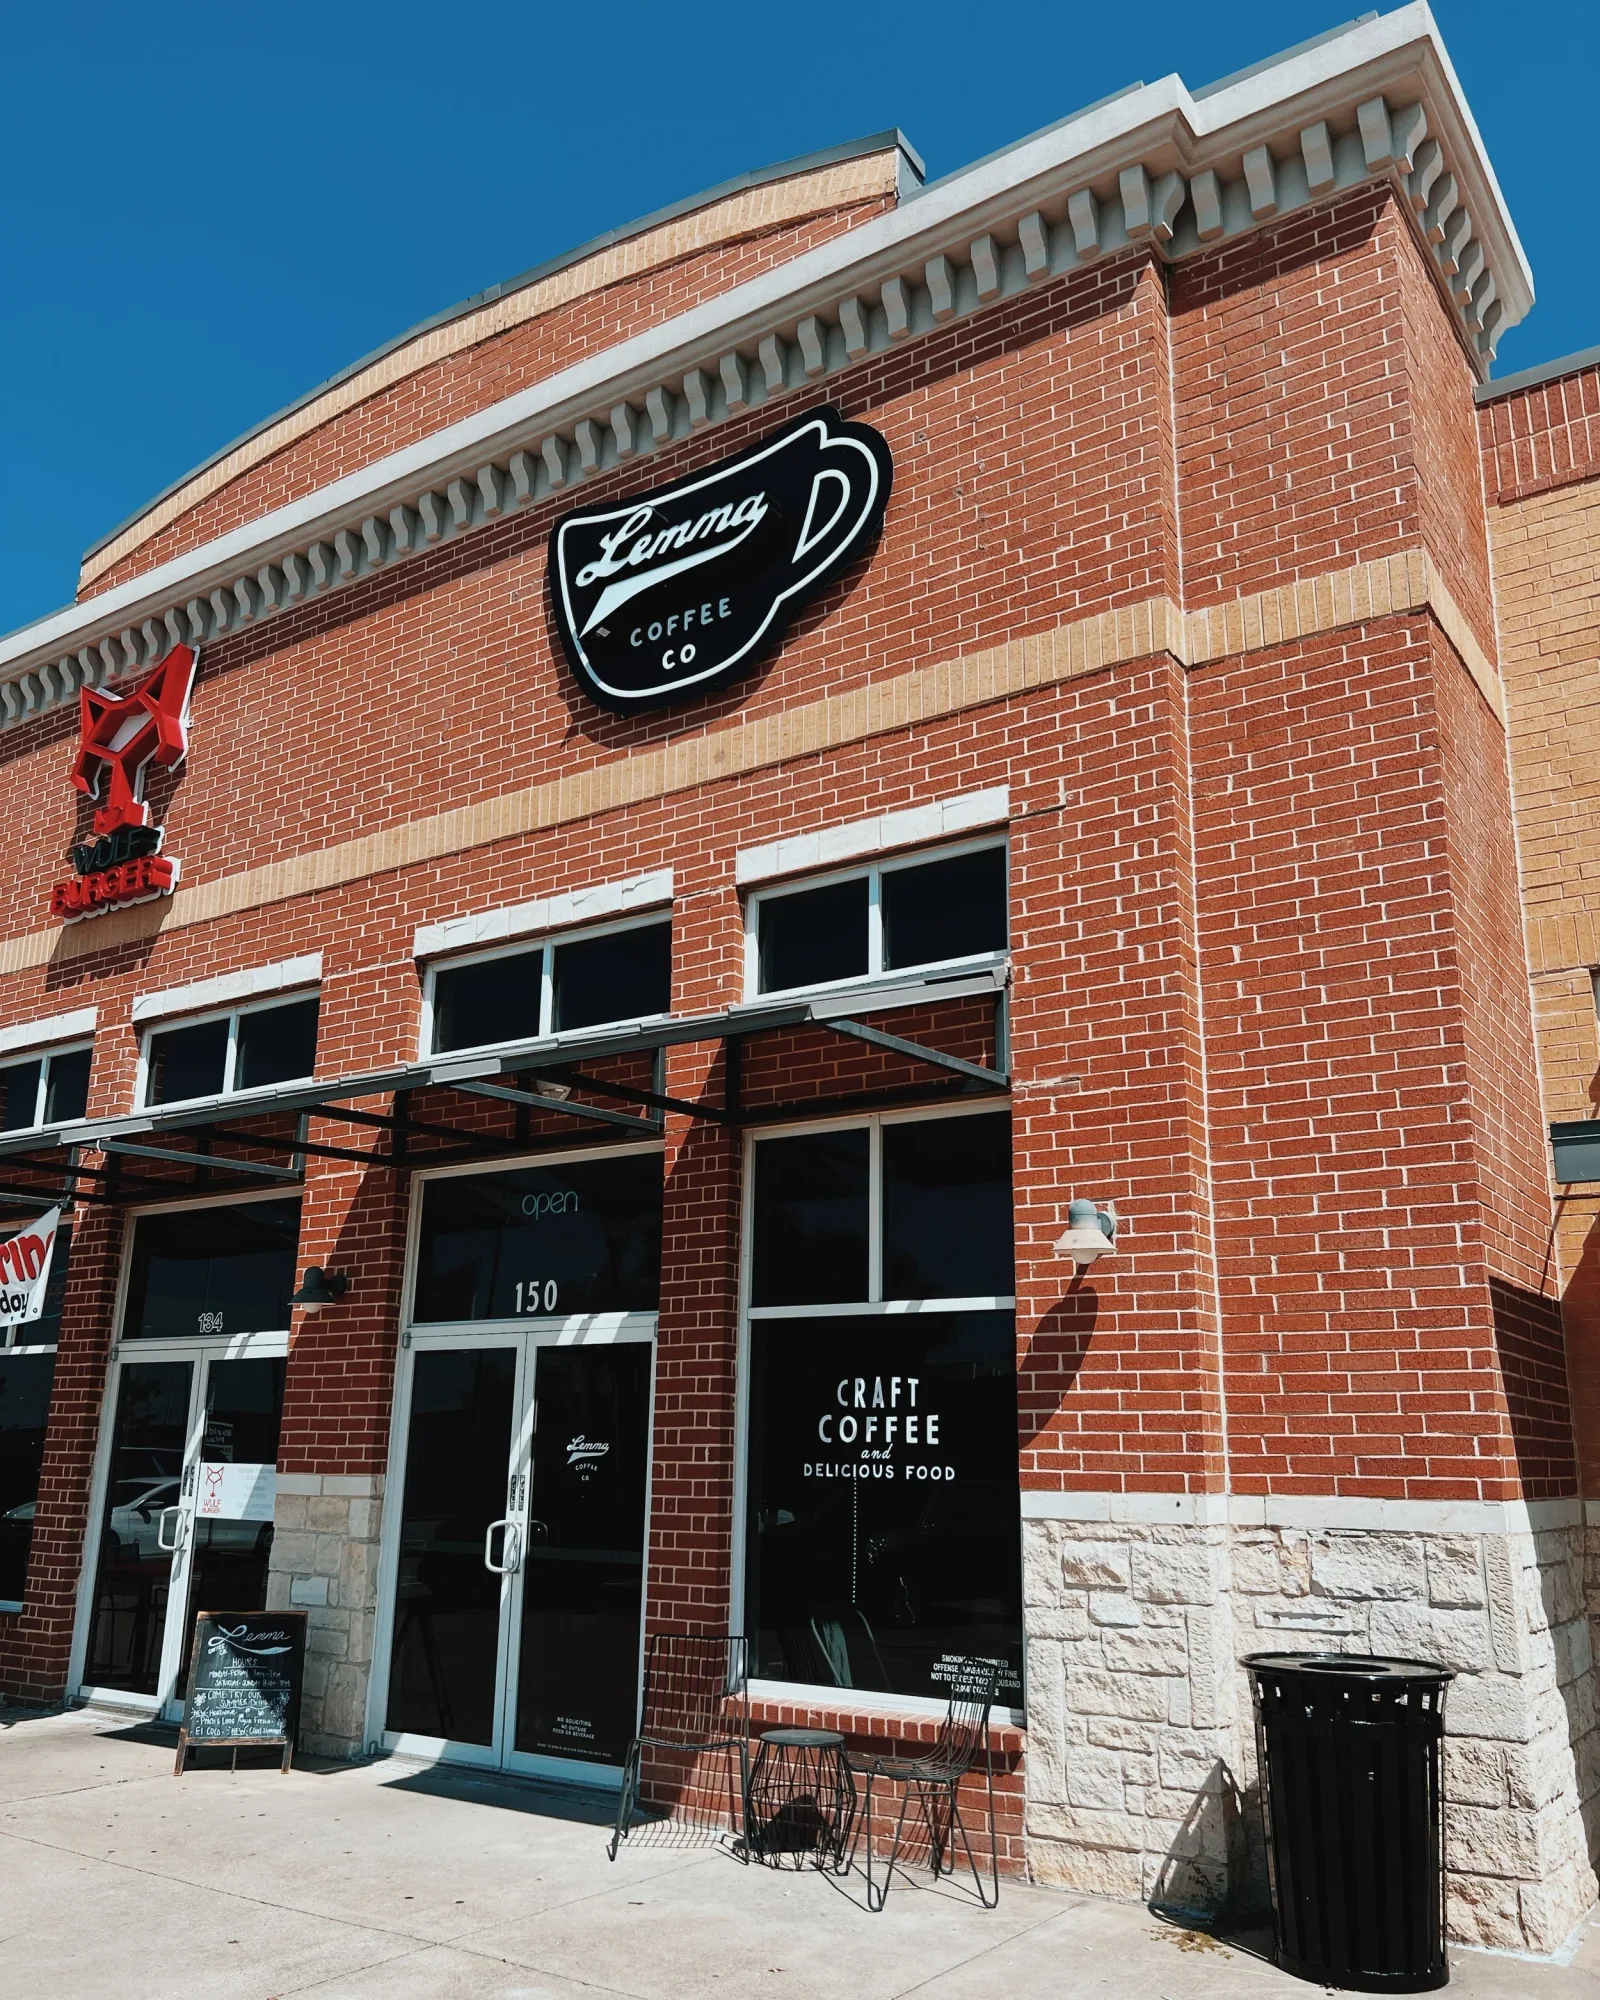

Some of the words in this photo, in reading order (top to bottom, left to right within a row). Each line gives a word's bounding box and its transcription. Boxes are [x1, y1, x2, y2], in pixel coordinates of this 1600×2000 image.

[575, 490, 769, 598] Lemma
[630, 597, 732, 648] COFFEE
[661, 643, 696, 670] CO
[73, 828, 150, 875] WULF
[50, 855, 163, 917] BURGER
[522, 1190, 578, 1221] open
[0, 1231, 55, 1285] rin
[515, 1279, 558, 1313] 150
[198, 1312, 223, 1333] 134
[836, 1376, 919, 1408] CRAFT
[818, 1414, 940, 1445] COFFEE
[566, 1435, 609, 1454] Lemma
[861, 1443, 893, 1459] and
[575, 1463, 598, 1472] COFFEE
[803, 1463, 895, 1479] DELICIOUS
[906, 1465, 955, 1481] FOOD
[203, 1498, 222, 1508] WULF
[208, 1624, 291, 1652] Lemma
[232, 1657, 258, 1668] HOURS
[933, 1663, 959, 1673] OFFENSE
[1004, 1669, 1018, 1679] FINE
[974, 1656, 1009, 1668] OHIBITED
[930, 1672, 942, 1681] NOT
[943, 1673, 952, 1682] TO
[952, 1674, 973, 1684] ECEED
[565, 1717, 592, 1727] SOLICITING
